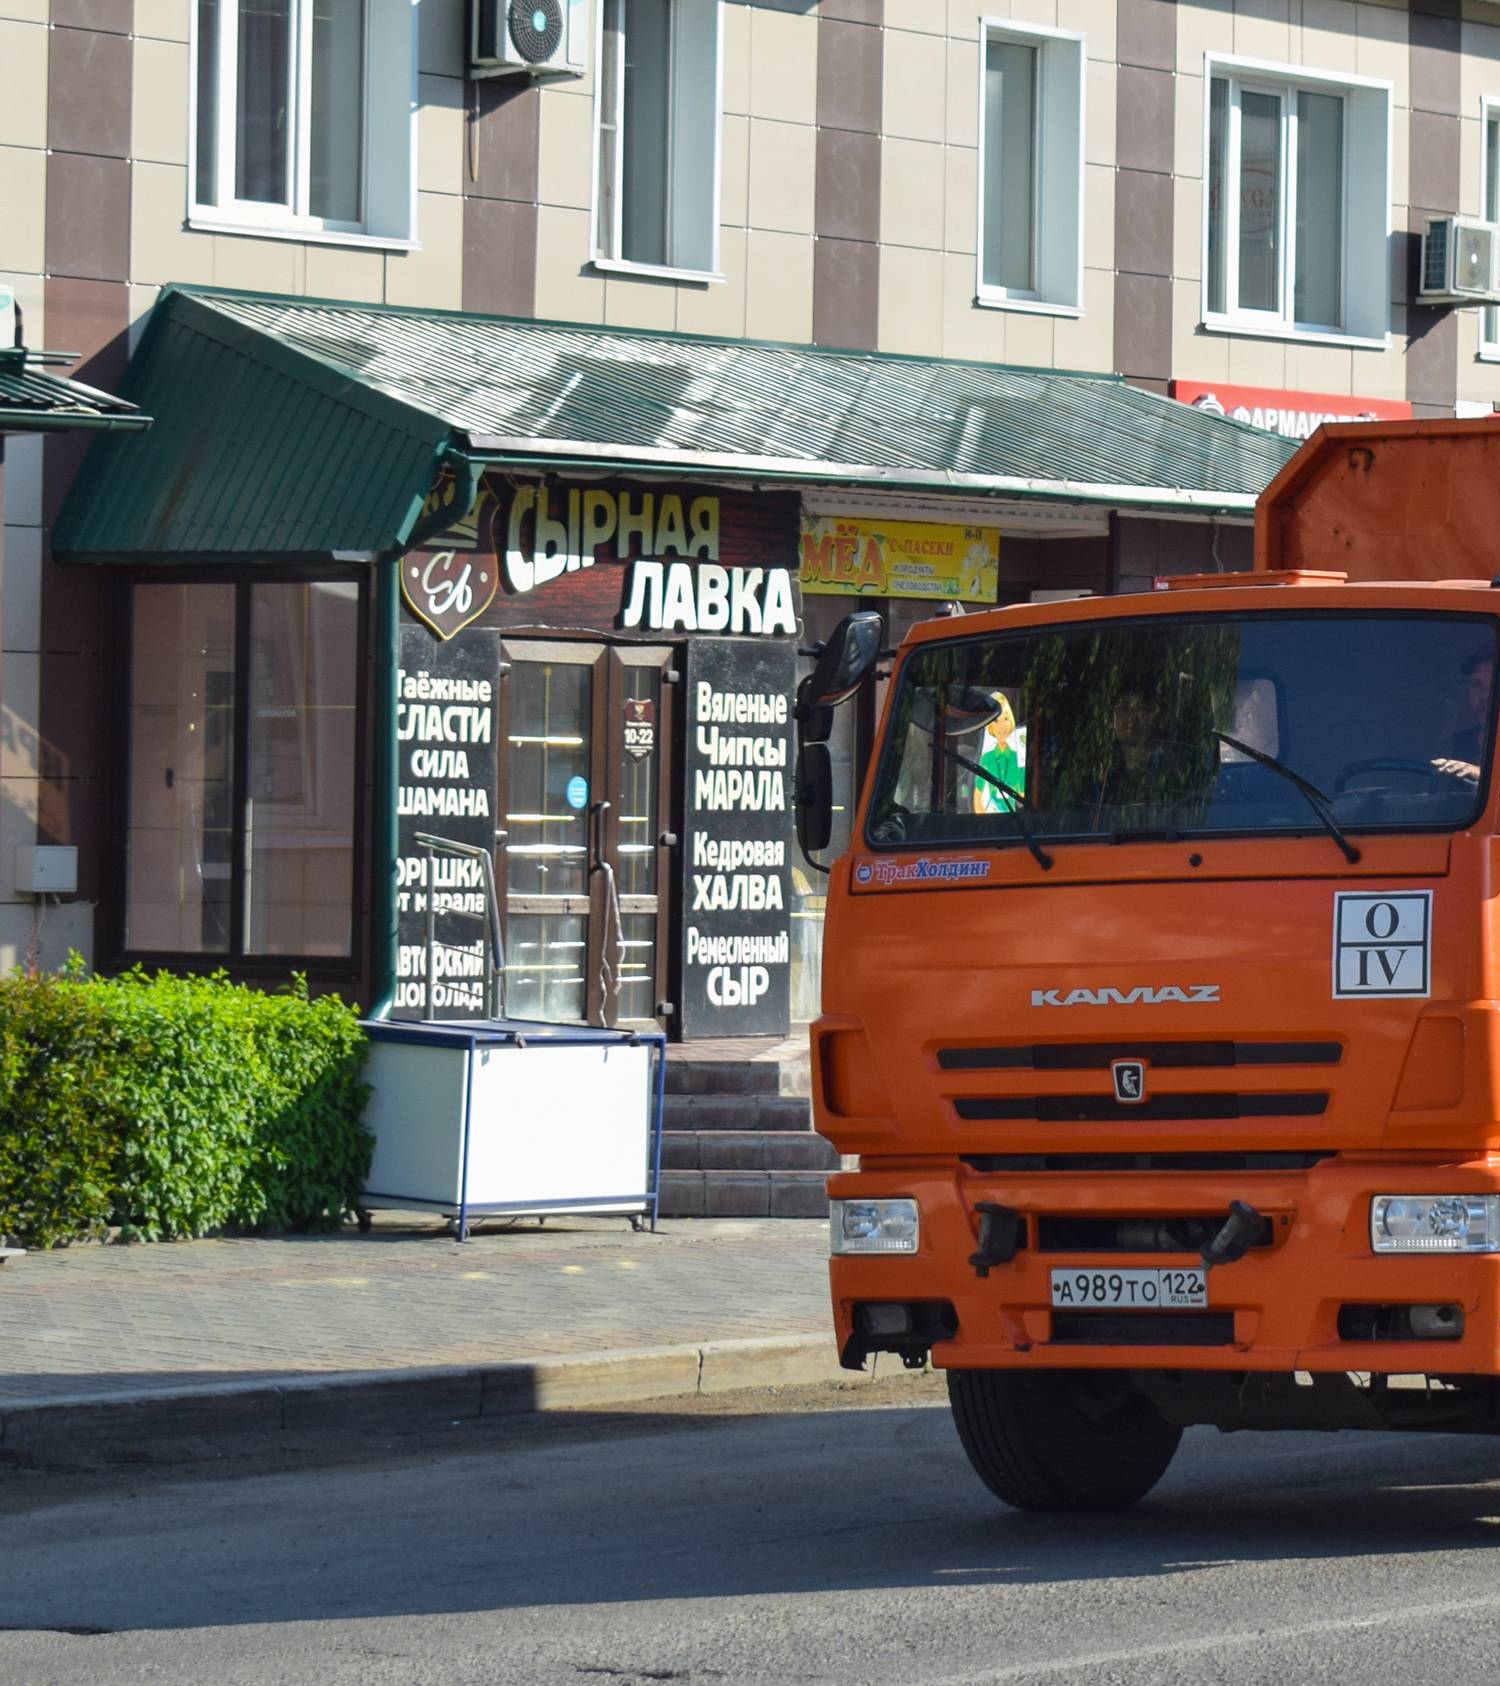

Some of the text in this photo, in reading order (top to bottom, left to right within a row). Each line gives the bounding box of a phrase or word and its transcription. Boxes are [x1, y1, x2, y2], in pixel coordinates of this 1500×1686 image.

[505, 486, 721, 594] СЫРНАЯ
[801, 523, 889, 594] МЁД
[902, 538, 954, 558] ПАСЕКИ
[623, 559, 798, 634] ЛАВКА
[397, 668, 492, 702] Таёжные
[696, 681, 788, 725] Вяленые
[624, 728, 654, 744] 10-22
[696, 725, 787, 767] Чипсы
[410, 749, 470, 779] СИЛА
[695, 769, 786, 811] МАРАЛА
[693, 831, 785, 872] Кедровая
[692, 874, 784, 911] ХАЛВА
[686, 926, 789, 965] Ремесленный
[706, 966, 770, 1007] СЫР
[1355, 948, 1408, 986] IV
[1031, 984, 1221, 1007] KAMAZ
[1162, 1272, 1199, 1295] 122
[1170, 1295, 1189, 1303] RUS
